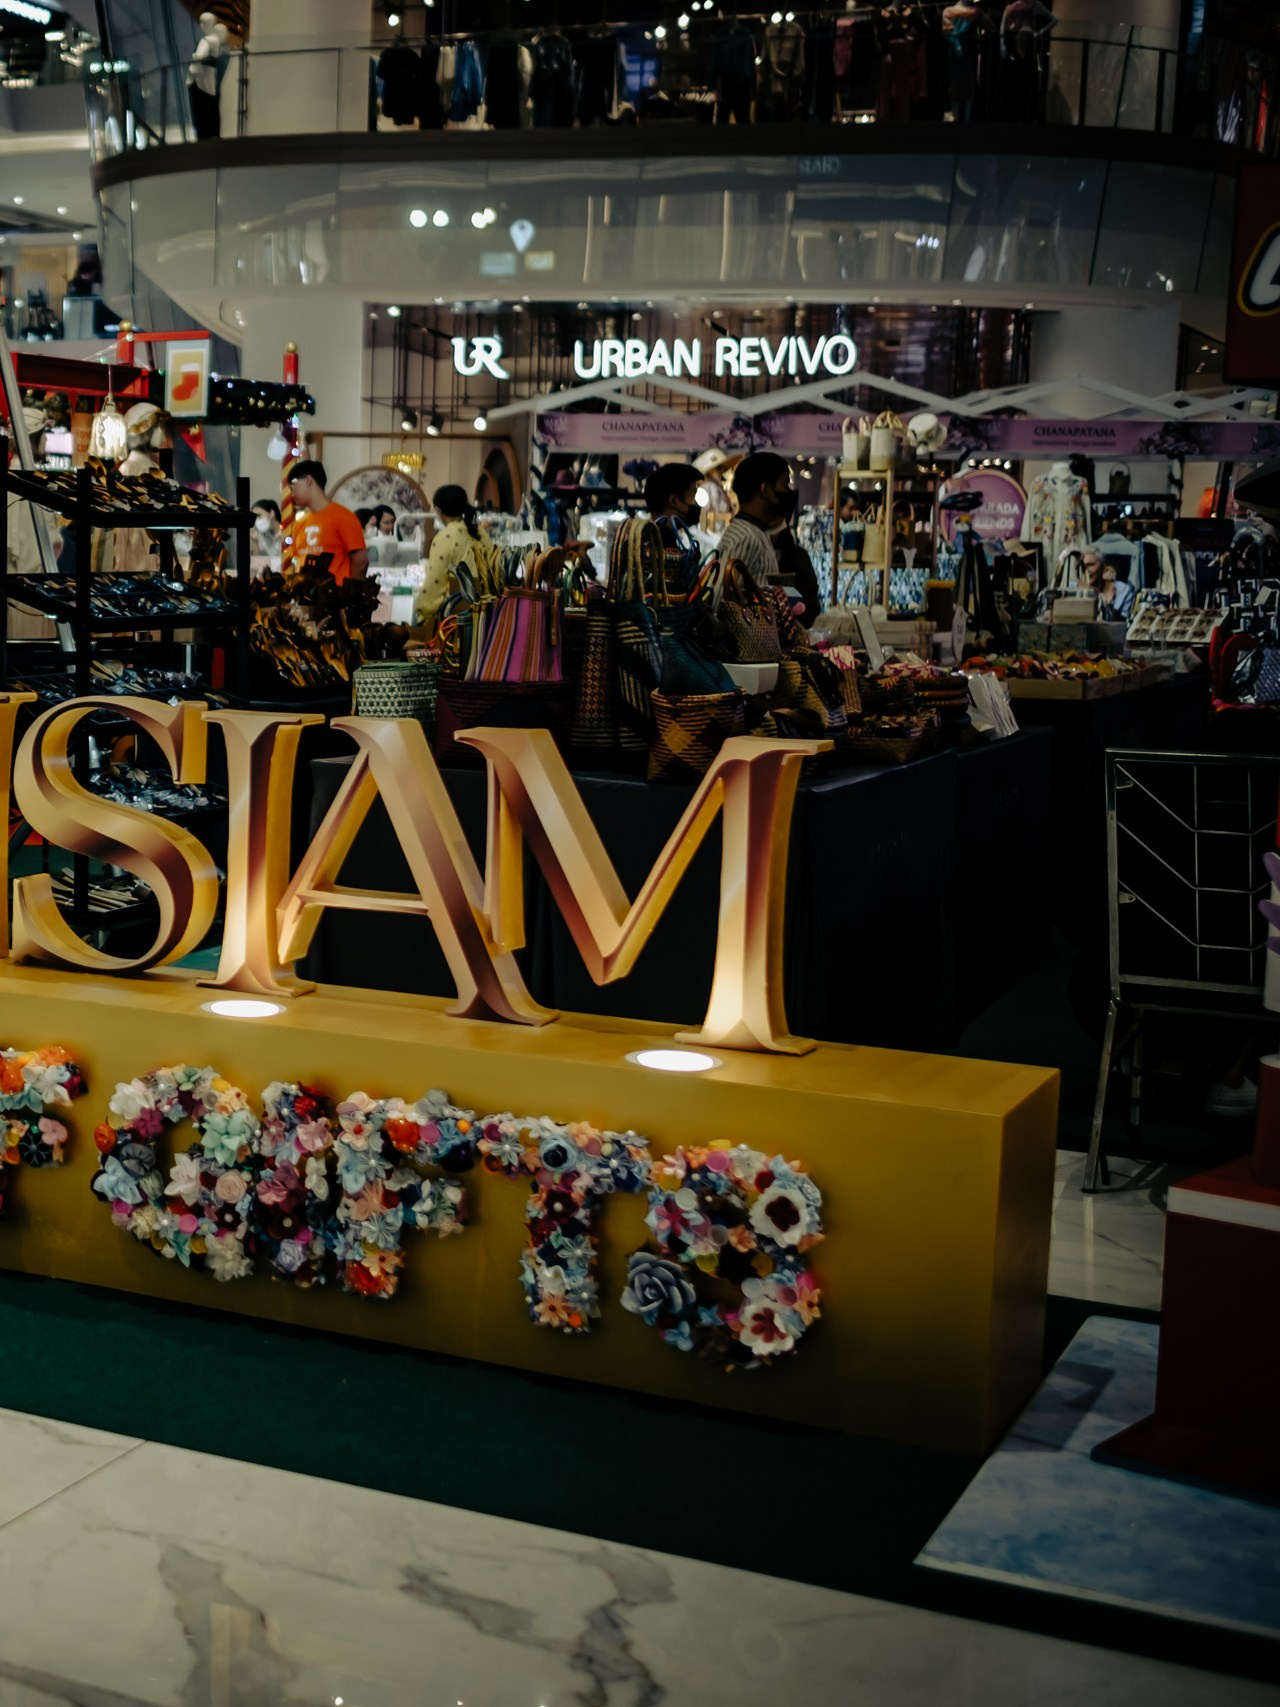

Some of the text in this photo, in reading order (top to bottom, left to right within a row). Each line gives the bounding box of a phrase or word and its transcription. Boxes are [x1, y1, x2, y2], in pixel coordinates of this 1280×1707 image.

[450, 335, 510, 380] UR
[573, 334, 858, 379] URBAN REVIVO
[601, 420, 685, 433] CHANAPATANA
[1033, 425, 1116, 438] CHANAPATANA
[90, 1062, 825, 1373] CRAFTS
